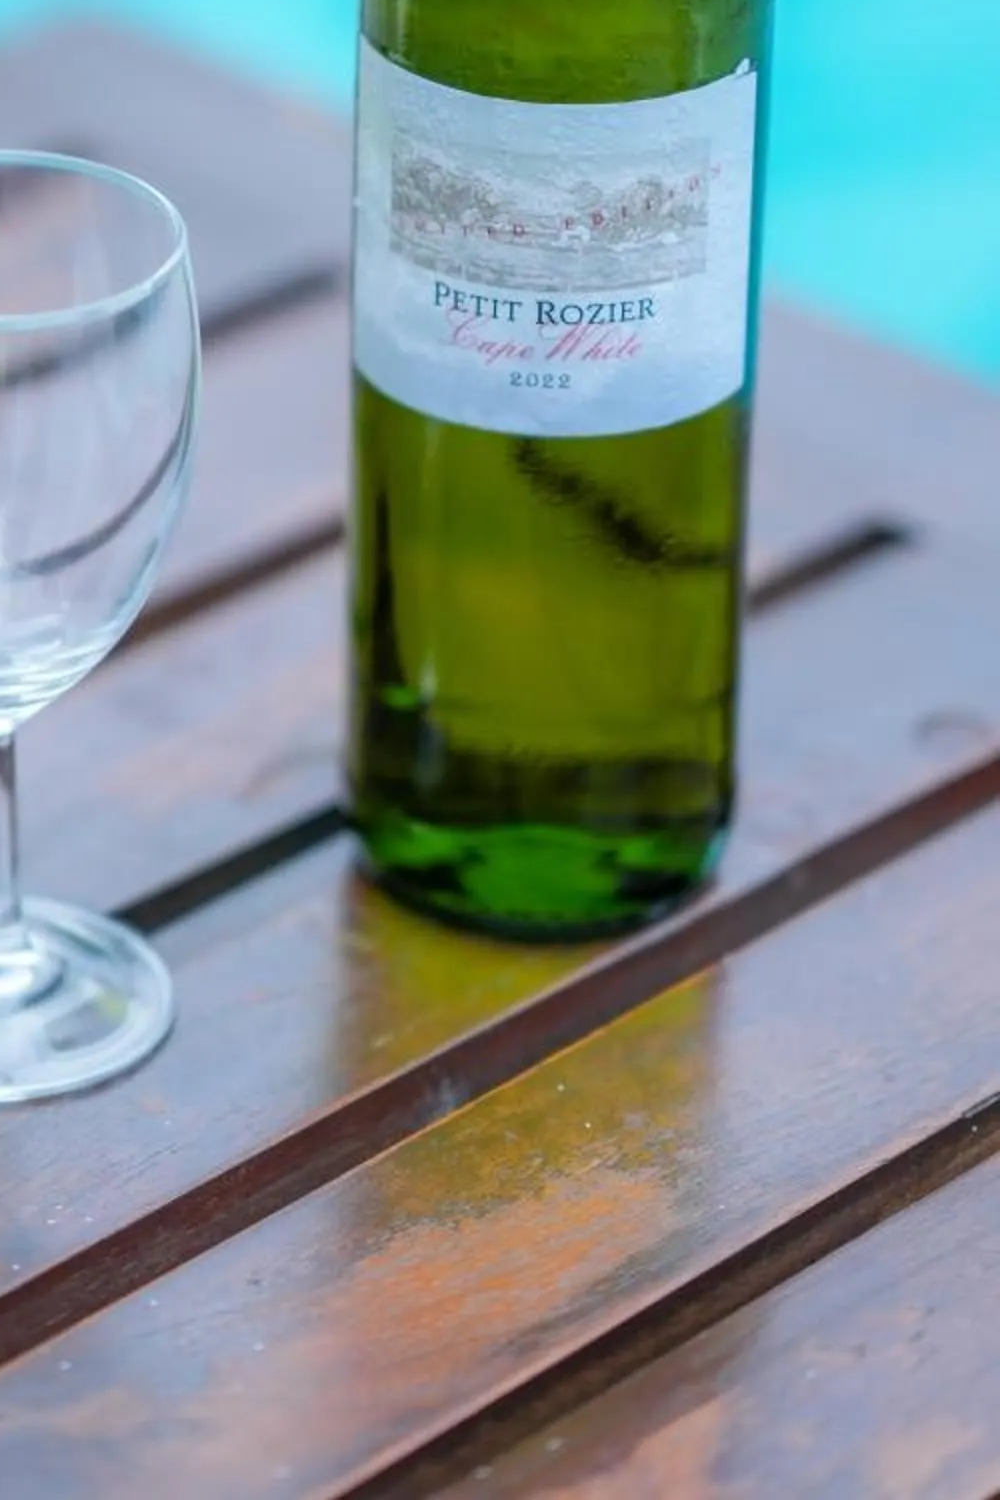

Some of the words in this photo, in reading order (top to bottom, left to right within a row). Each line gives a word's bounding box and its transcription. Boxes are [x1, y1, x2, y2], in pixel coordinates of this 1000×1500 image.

[434, 280, 523, 323] PETIT
[535, 296, 655, 325] ROZIER
[444, 304, 535, 366] Cape
[538, 322, 645, 362] White
[509, 371, 572, 389] 2022
